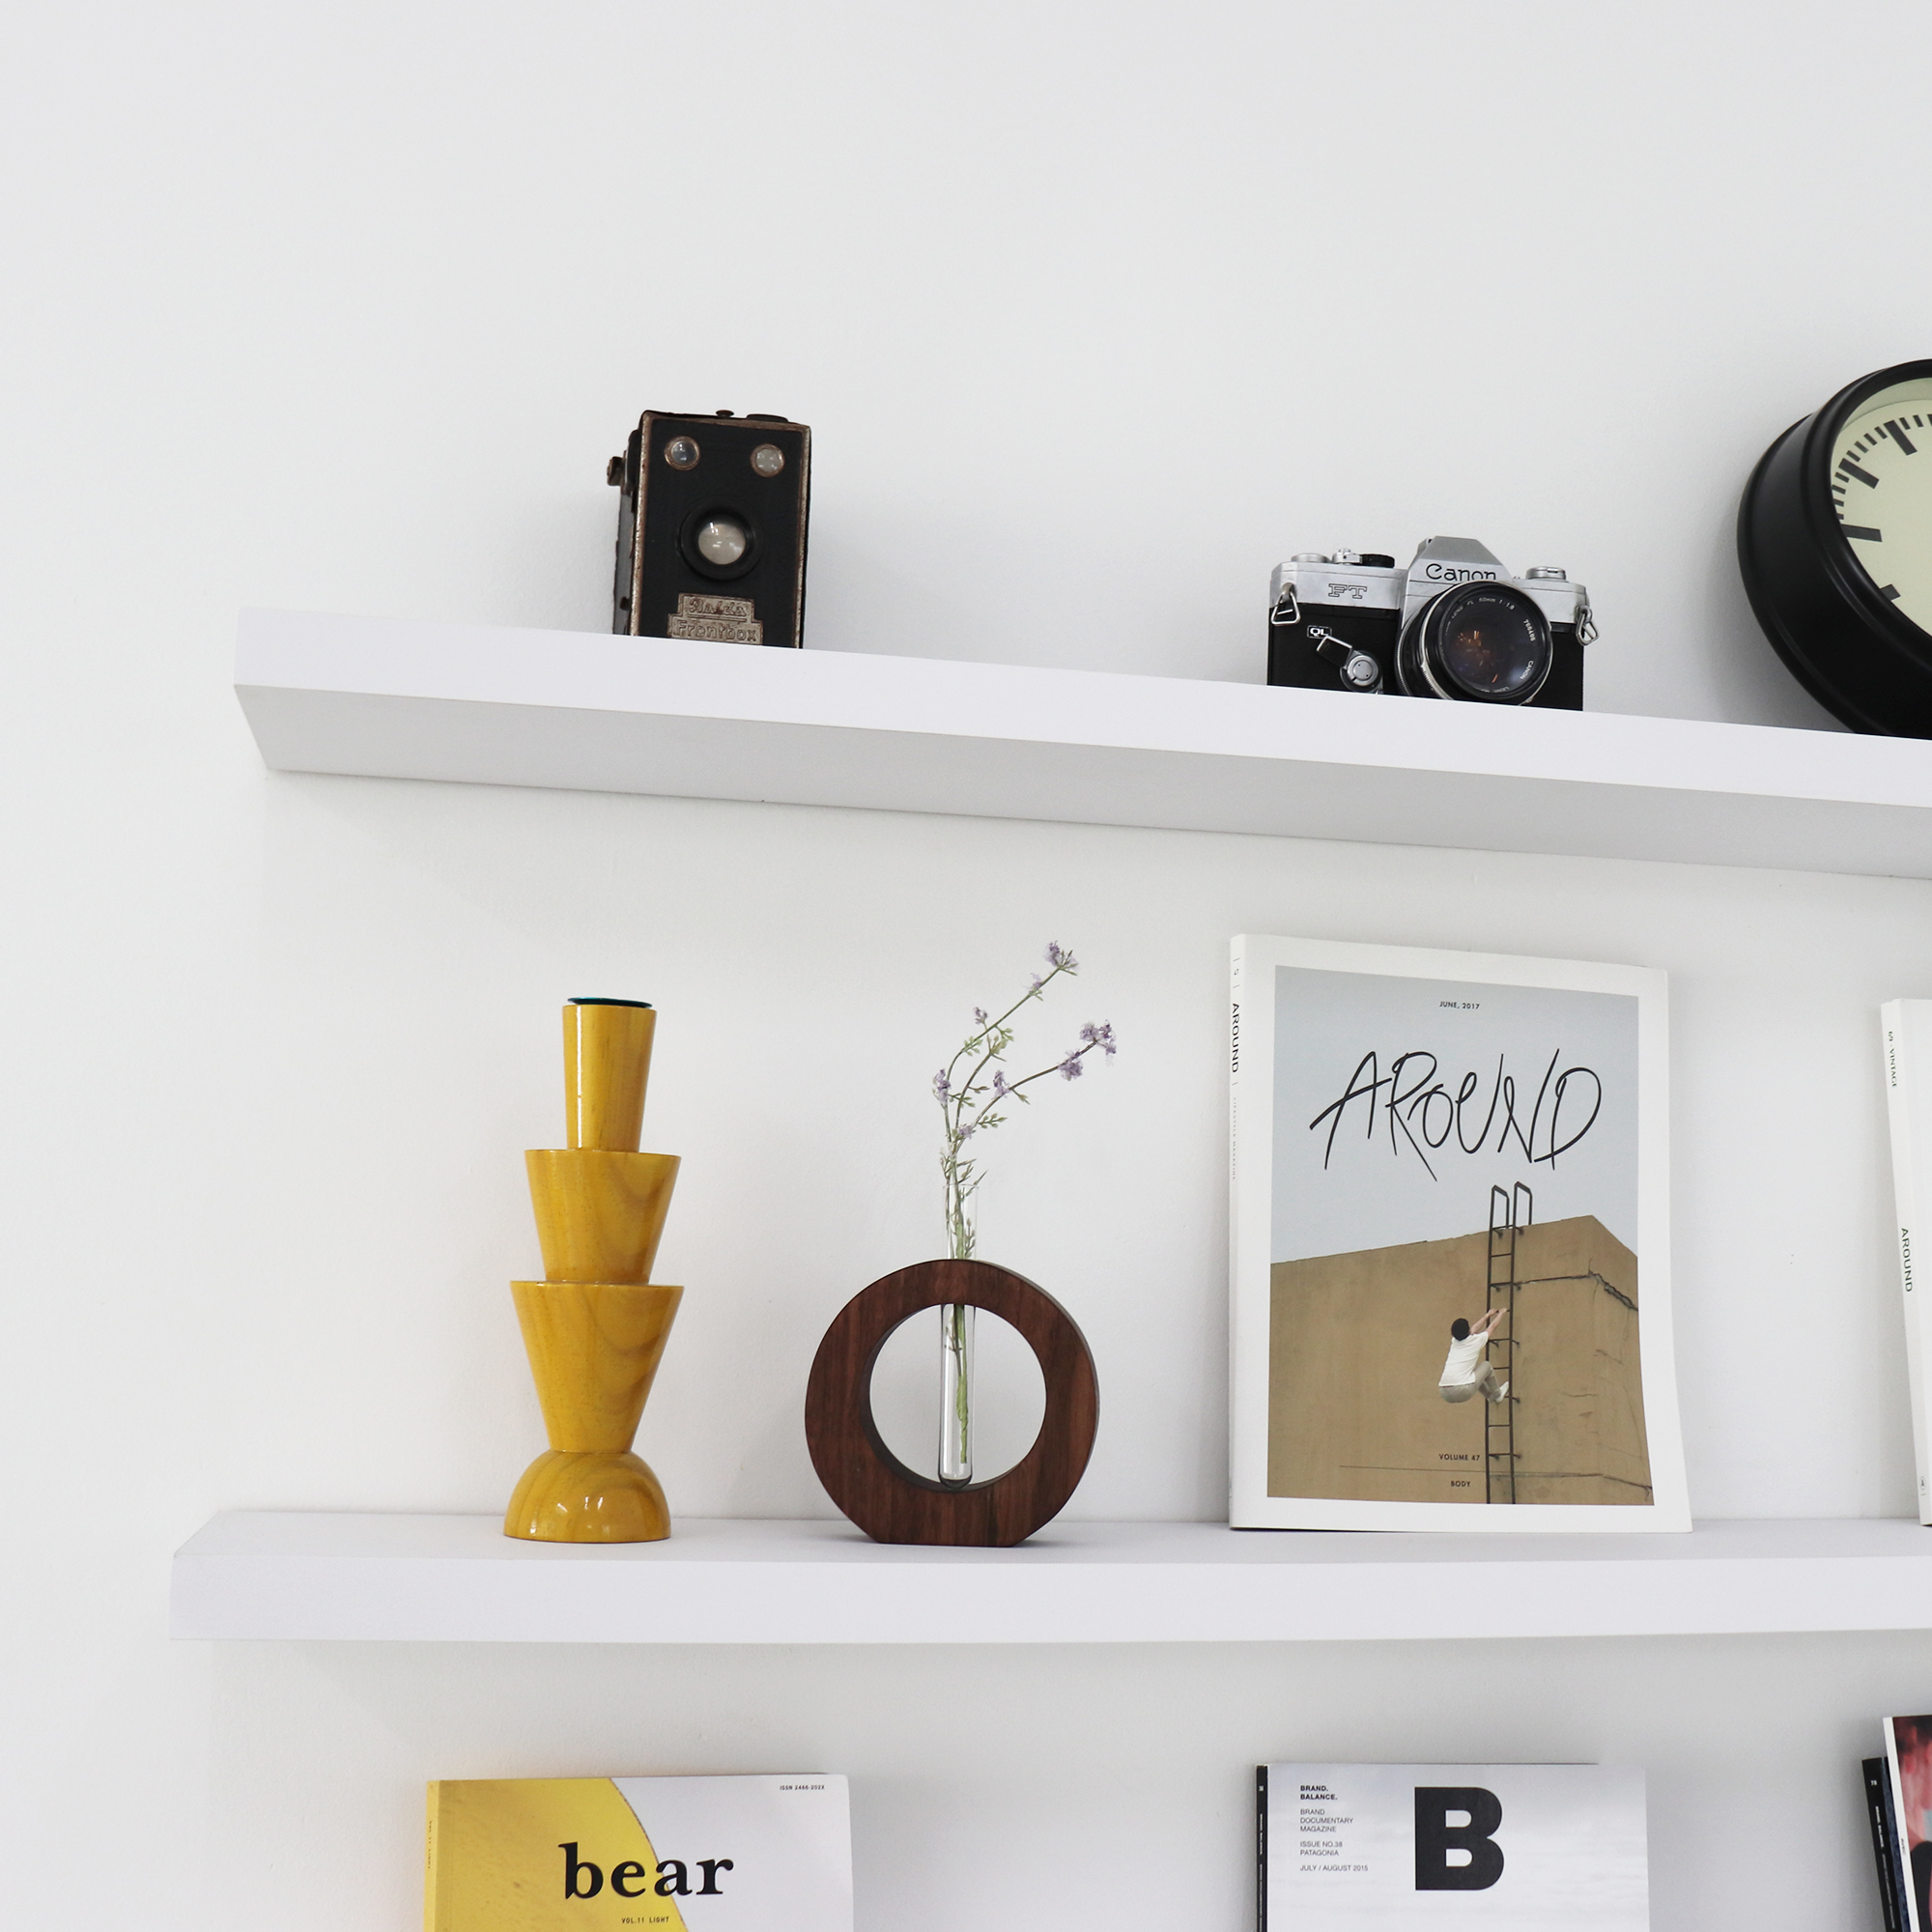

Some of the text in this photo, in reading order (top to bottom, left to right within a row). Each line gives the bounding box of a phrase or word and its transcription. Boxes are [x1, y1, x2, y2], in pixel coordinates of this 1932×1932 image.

[1426, 563, 1496, 582] Canon
[1327, 582, 1368, 600] FT
[678, 619, 756, 641] Frontbox
[1310, 628, 1329, 638] QL
[1520, 660, 1534, 680] CANON
[1439, 1001, 1460, 1009] JUNE,
[1889, 1031, 1893, 1041] 69
[1309, 1048, 1602, 1181] AROUND
[1901, 1227, 1913, 1293] AROUND
[1414, 1787, 1504, 1890] B
[557, 1842, 734, 1899] bear
